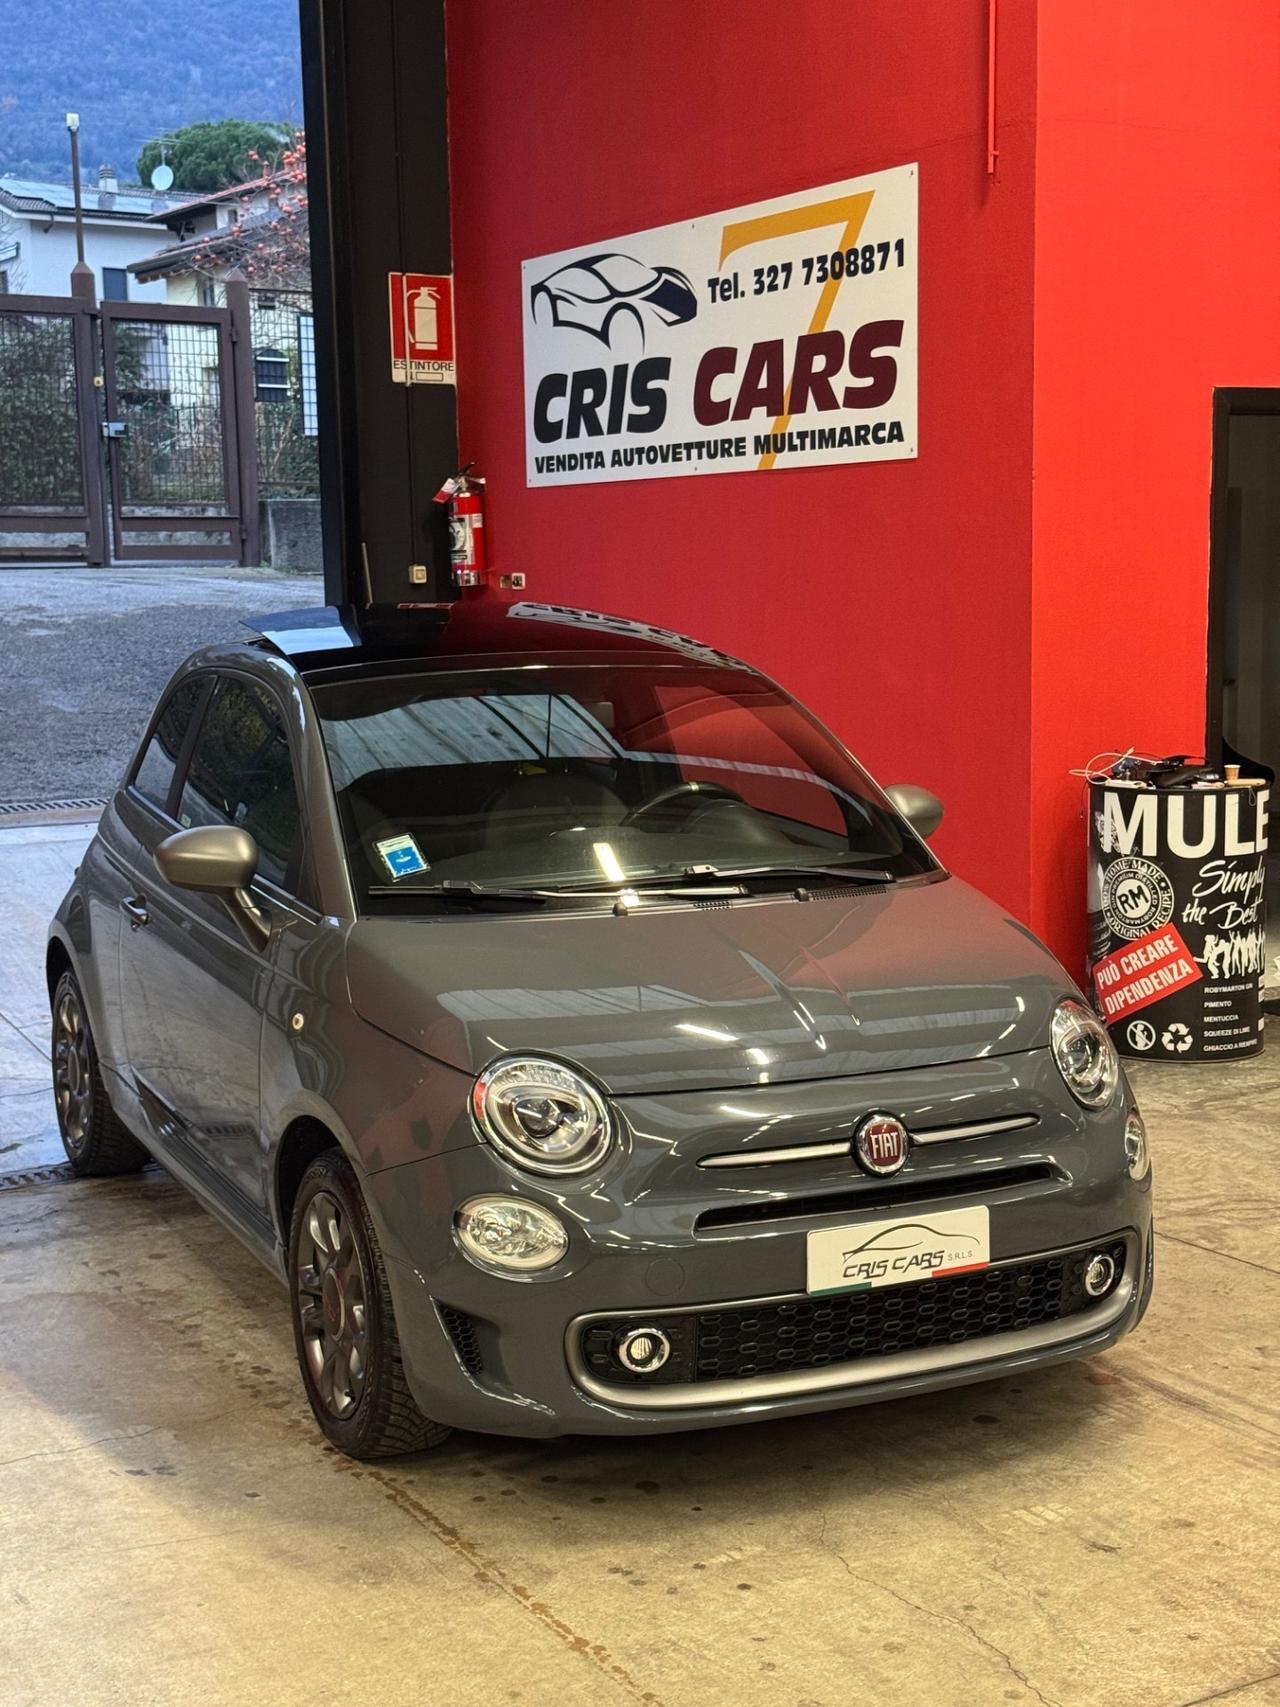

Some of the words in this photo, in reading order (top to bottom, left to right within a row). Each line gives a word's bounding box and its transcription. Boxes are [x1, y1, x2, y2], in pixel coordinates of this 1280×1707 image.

[708, 276, 745, 304] Tel.
[754, 262, 793, 295] 327
[802, 239, 904, 285] 7308871
[393, 360, 454, 371] ESTINTORE
[533, 357, 671, 444] CRIS
[693, 319, 904, 426] CARS
[535, 450, 605, 474] VENDITA
[611, 437, 746, 468] AUTOVETTURE
[754, 421, 904, 455] MULTIMARCA
[1103, 789, 1269, 859] MULE
[1106, 860, 1130, 882] HOME
[1132, 860, 1162, 882] MADE
[1192, 855, 1265, 904] Simply
[1117, 885, 1149, 914] RM
[1152, 889, 1172, 929] RECIPE
[1182, 898, 1207, 925] the
[1209, 896, 1263, 929] Best
[1096, 960, 1121, 990] PUÒ
[1120, 934, 1179, 976] CREARE
[1104, 958, 1194, 1015] DIPENDENZA
[1203, 1014, 1239, 1022] MENTUCCIA
[870, 1131, 899, 1160] FIAT
[842, 1260, 889, 1279] CRIS
[891, 1250, 945, 1273] CARS
